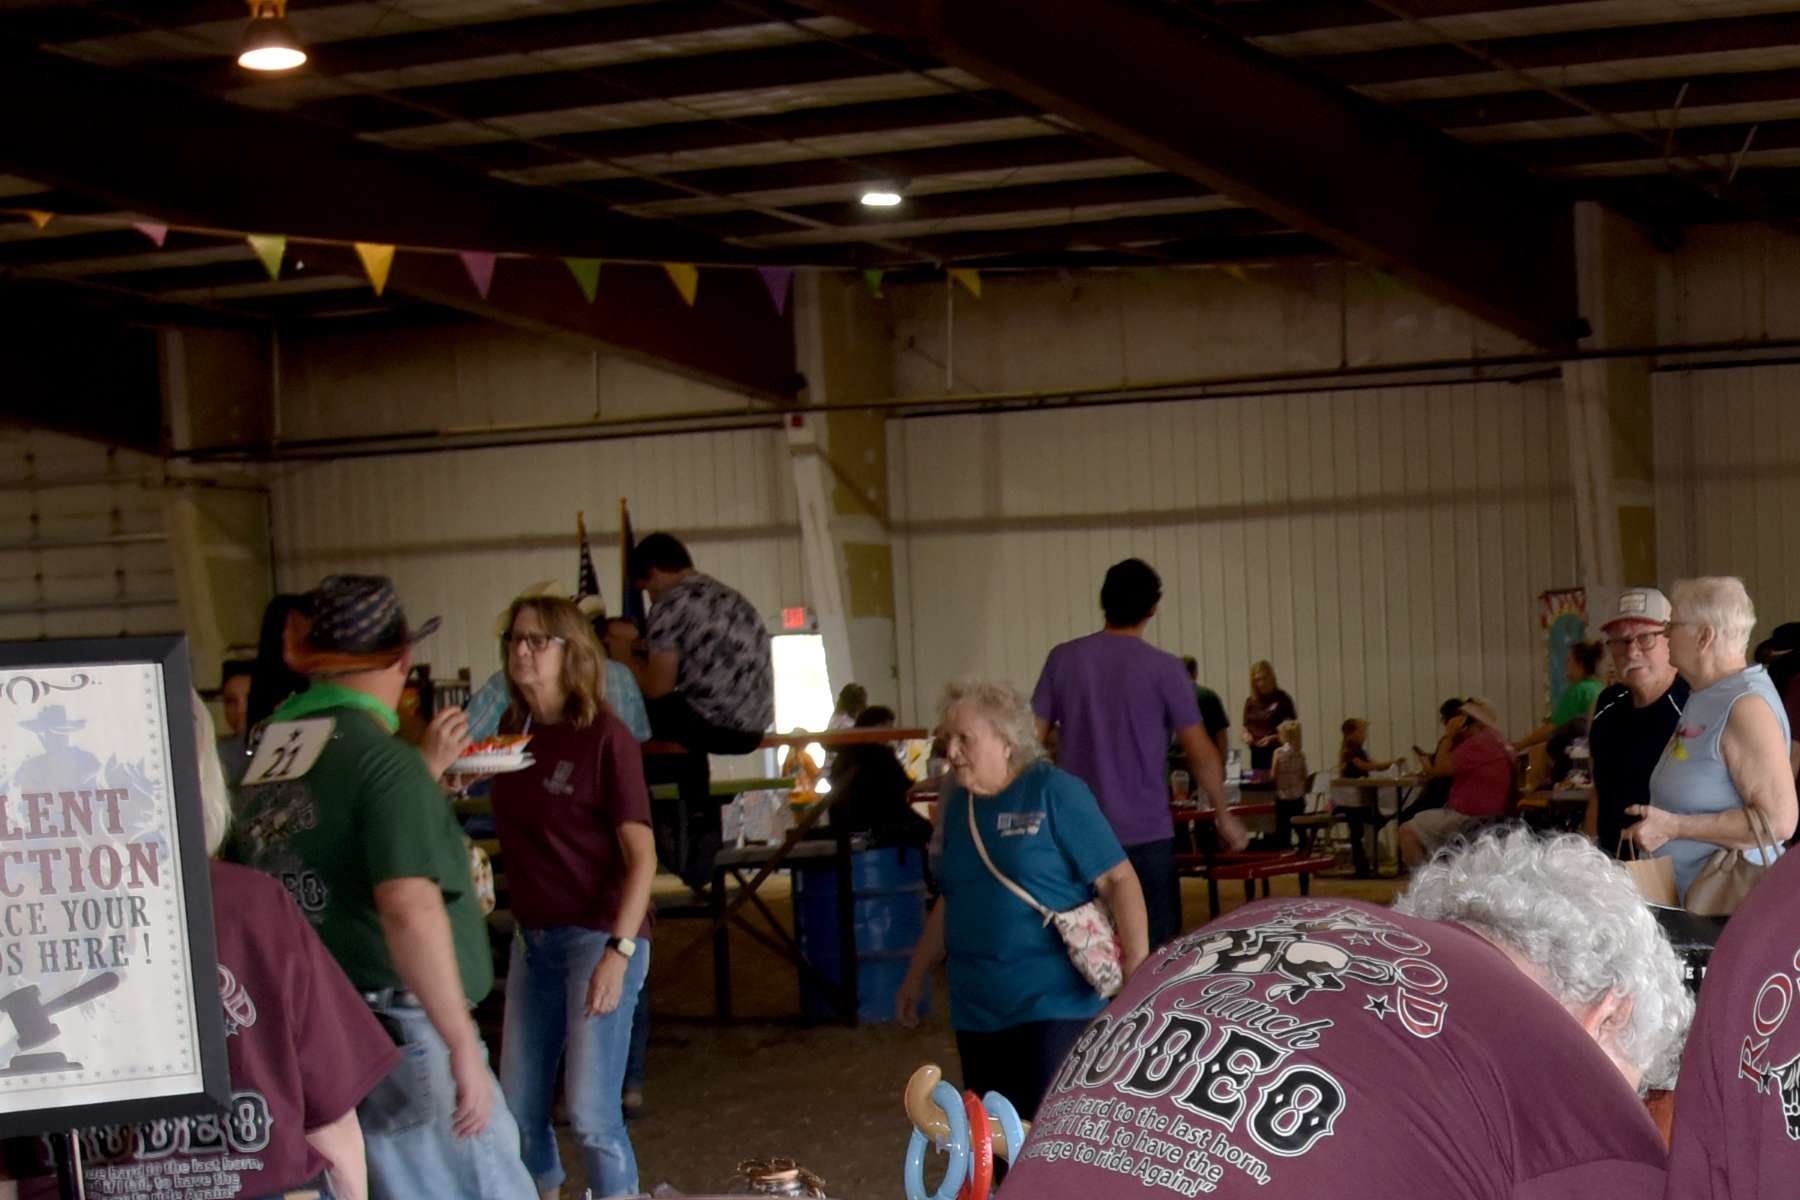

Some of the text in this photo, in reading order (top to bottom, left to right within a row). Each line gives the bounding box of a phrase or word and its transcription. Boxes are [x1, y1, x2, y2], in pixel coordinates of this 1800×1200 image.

[260, 746, 303, 779] 21
[61, 895, 151, 933] YOUR
[39, 934, 129, 973] HERE
[142, 932, 153, 965] !
[1174, 977, 1335, 1050] Ranch
[1074, 1142, 1096, 1165] to
[1094, 1147, 1134, 1175] ride
[1075, 1094, 1117, 1118] hard
[1113, 1102, 1136, 1124] to
[1135, 1106, 1169, 1132] the
[1169, 1115, 1212, 1149] last
[1211, 1133, 1272, 1186] horn,
[1112, 1127, 1135, 1148] to
[1135, 1131, 1183, 1164] have
[1183, 1149, 1224, 1184] the
